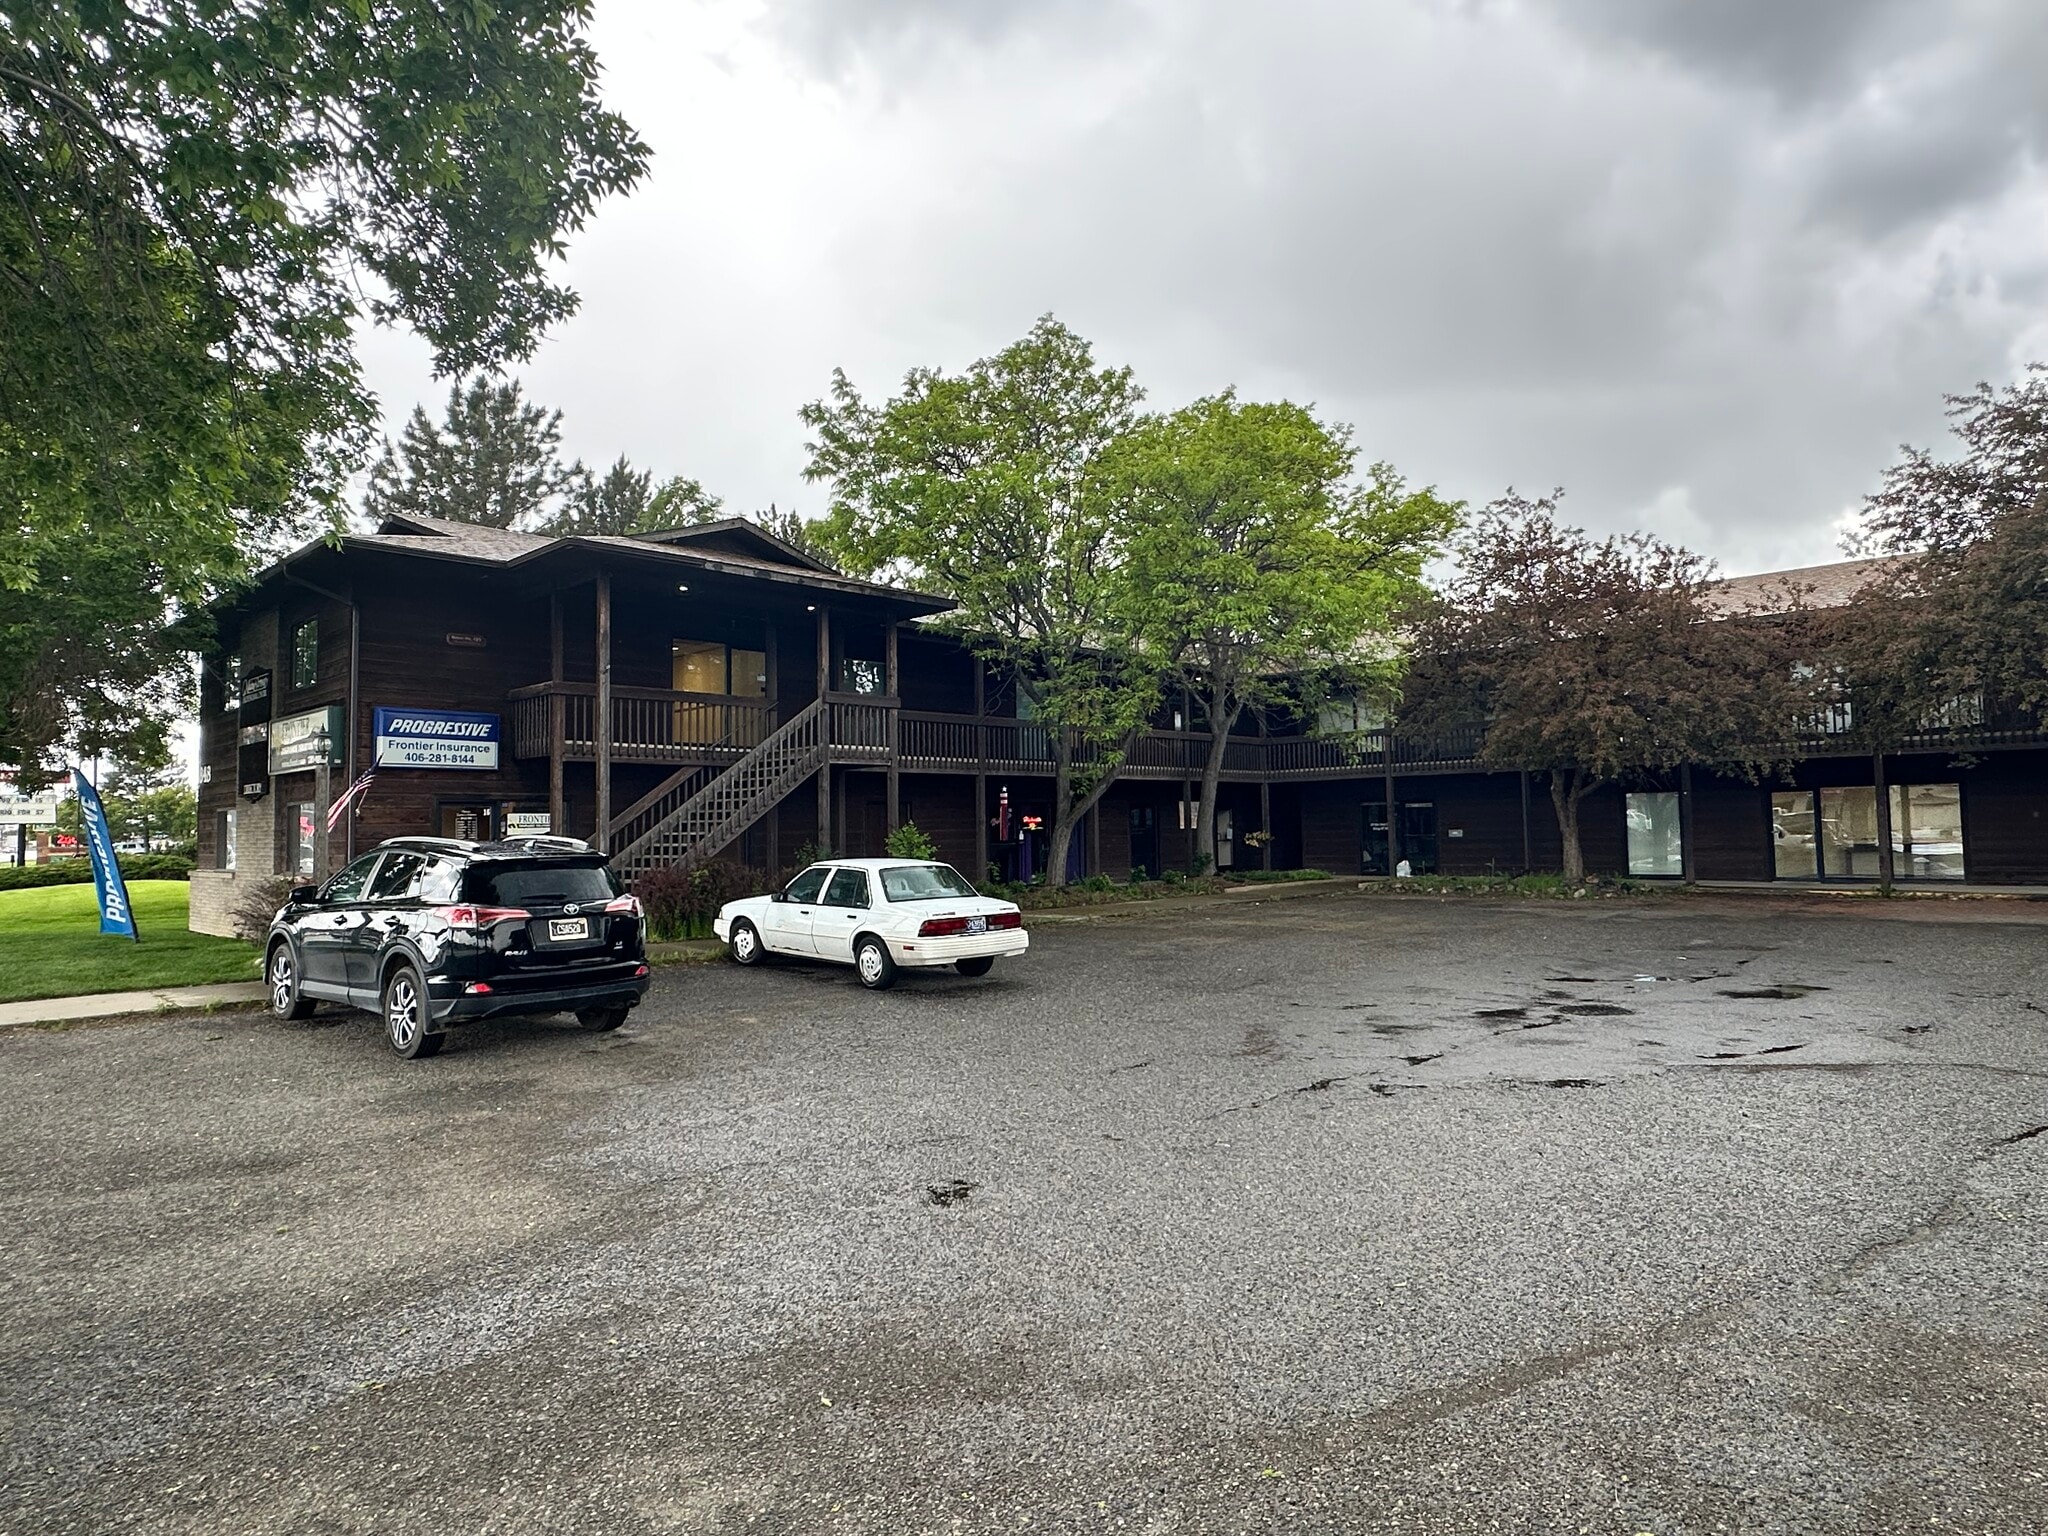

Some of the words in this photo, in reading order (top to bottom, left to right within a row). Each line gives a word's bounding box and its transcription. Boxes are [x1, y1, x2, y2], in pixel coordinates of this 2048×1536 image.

[388, 719, 492, 736] PROGRESSIVE
[388, 740, 433, 750] Frontier
[436, 742, 490, 753] Insurance
[404, 753, 475, 763] 406-281-8144
